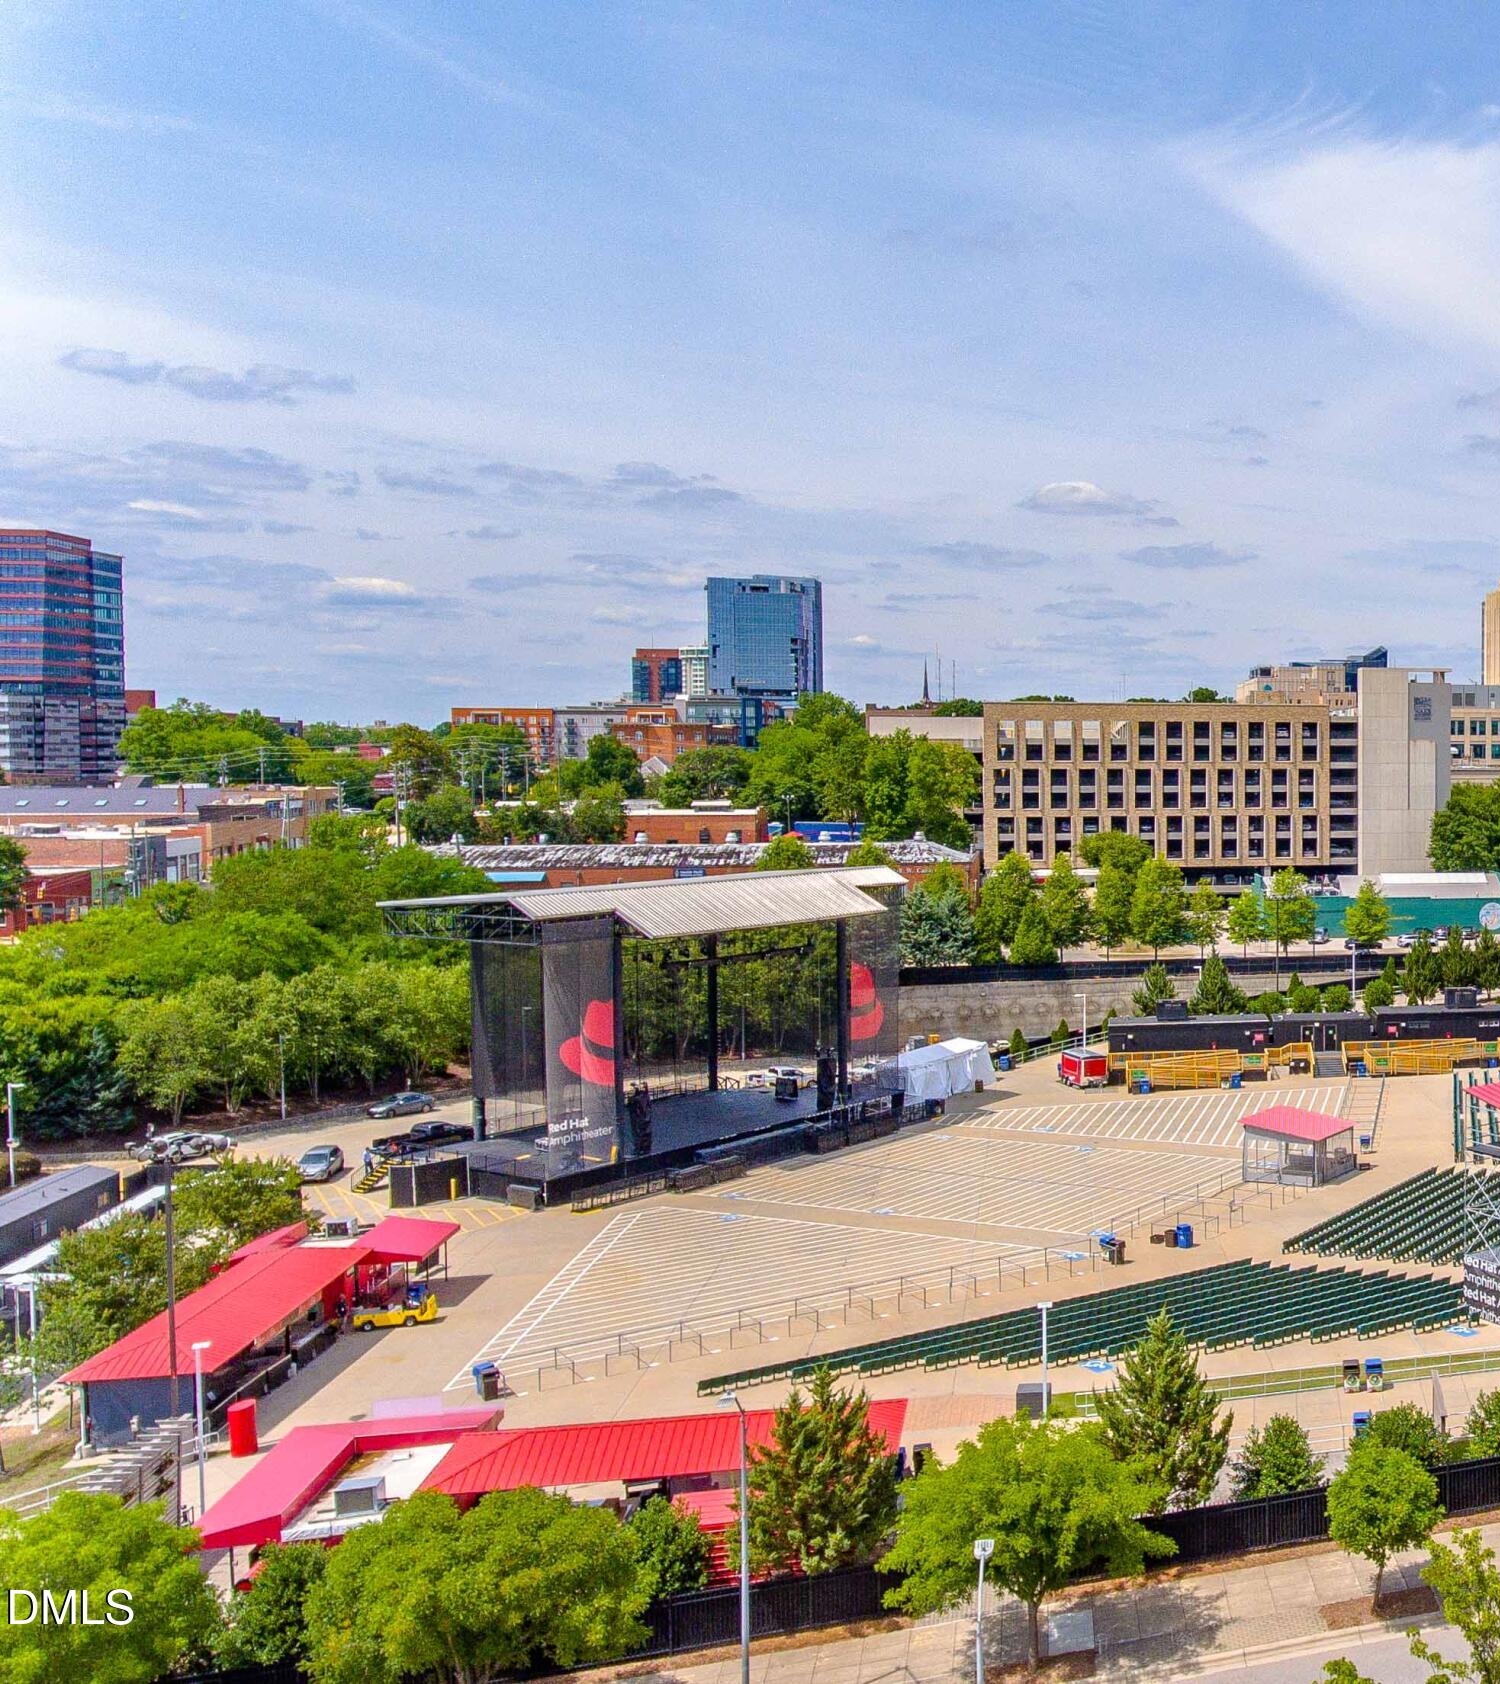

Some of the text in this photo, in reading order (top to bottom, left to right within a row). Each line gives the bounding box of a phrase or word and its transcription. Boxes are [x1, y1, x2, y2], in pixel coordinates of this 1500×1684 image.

[548, 1117, 589, 1133] Red Hat
[1480, 1259, 1497, 1274] Hat
[1479, 1290, 1496, 1307] Hat
